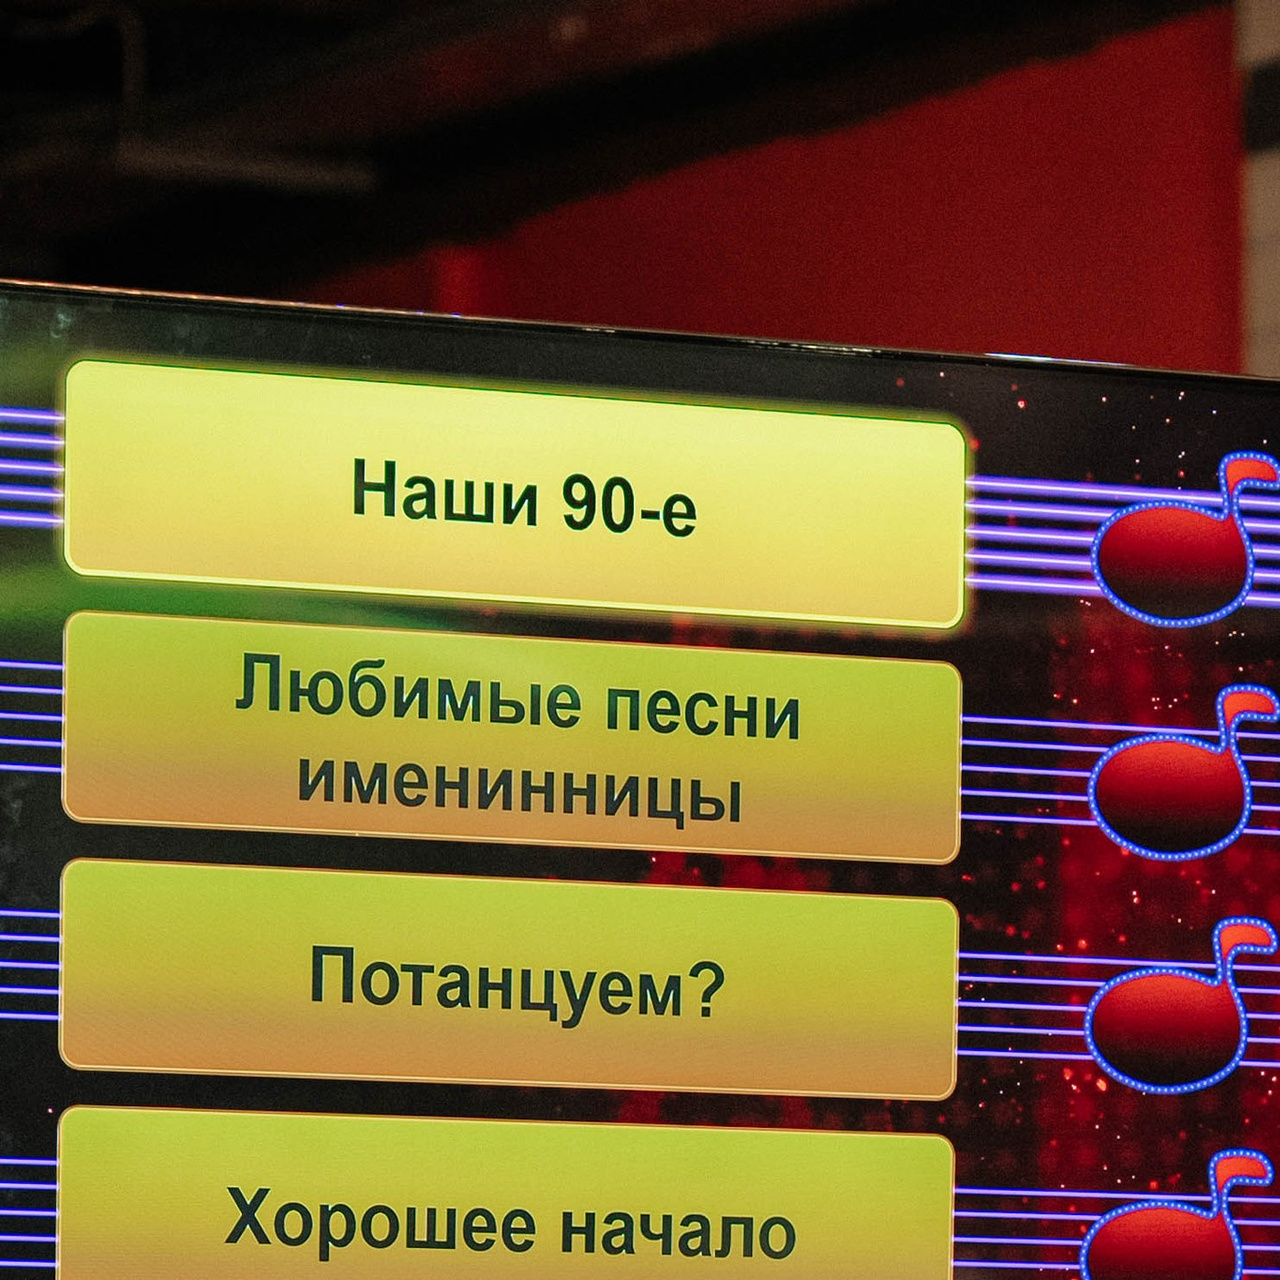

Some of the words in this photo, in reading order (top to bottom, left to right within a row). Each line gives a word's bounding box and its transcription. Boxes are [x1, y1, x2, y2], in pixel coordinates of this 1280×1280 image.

[352, 457, 539, 527] Наши
[562, 474, 698, 538] 90-е
[236, 651, 583, 729] Любимые
[606, 688, 802, 741] песни
[298, 757, 741, 831] именинницы
[310, 944, 728, 1029] Потанцуем?
[225, 1186, 538, 1262] Хорошее
[562, 1205, 797, 1260] начало
